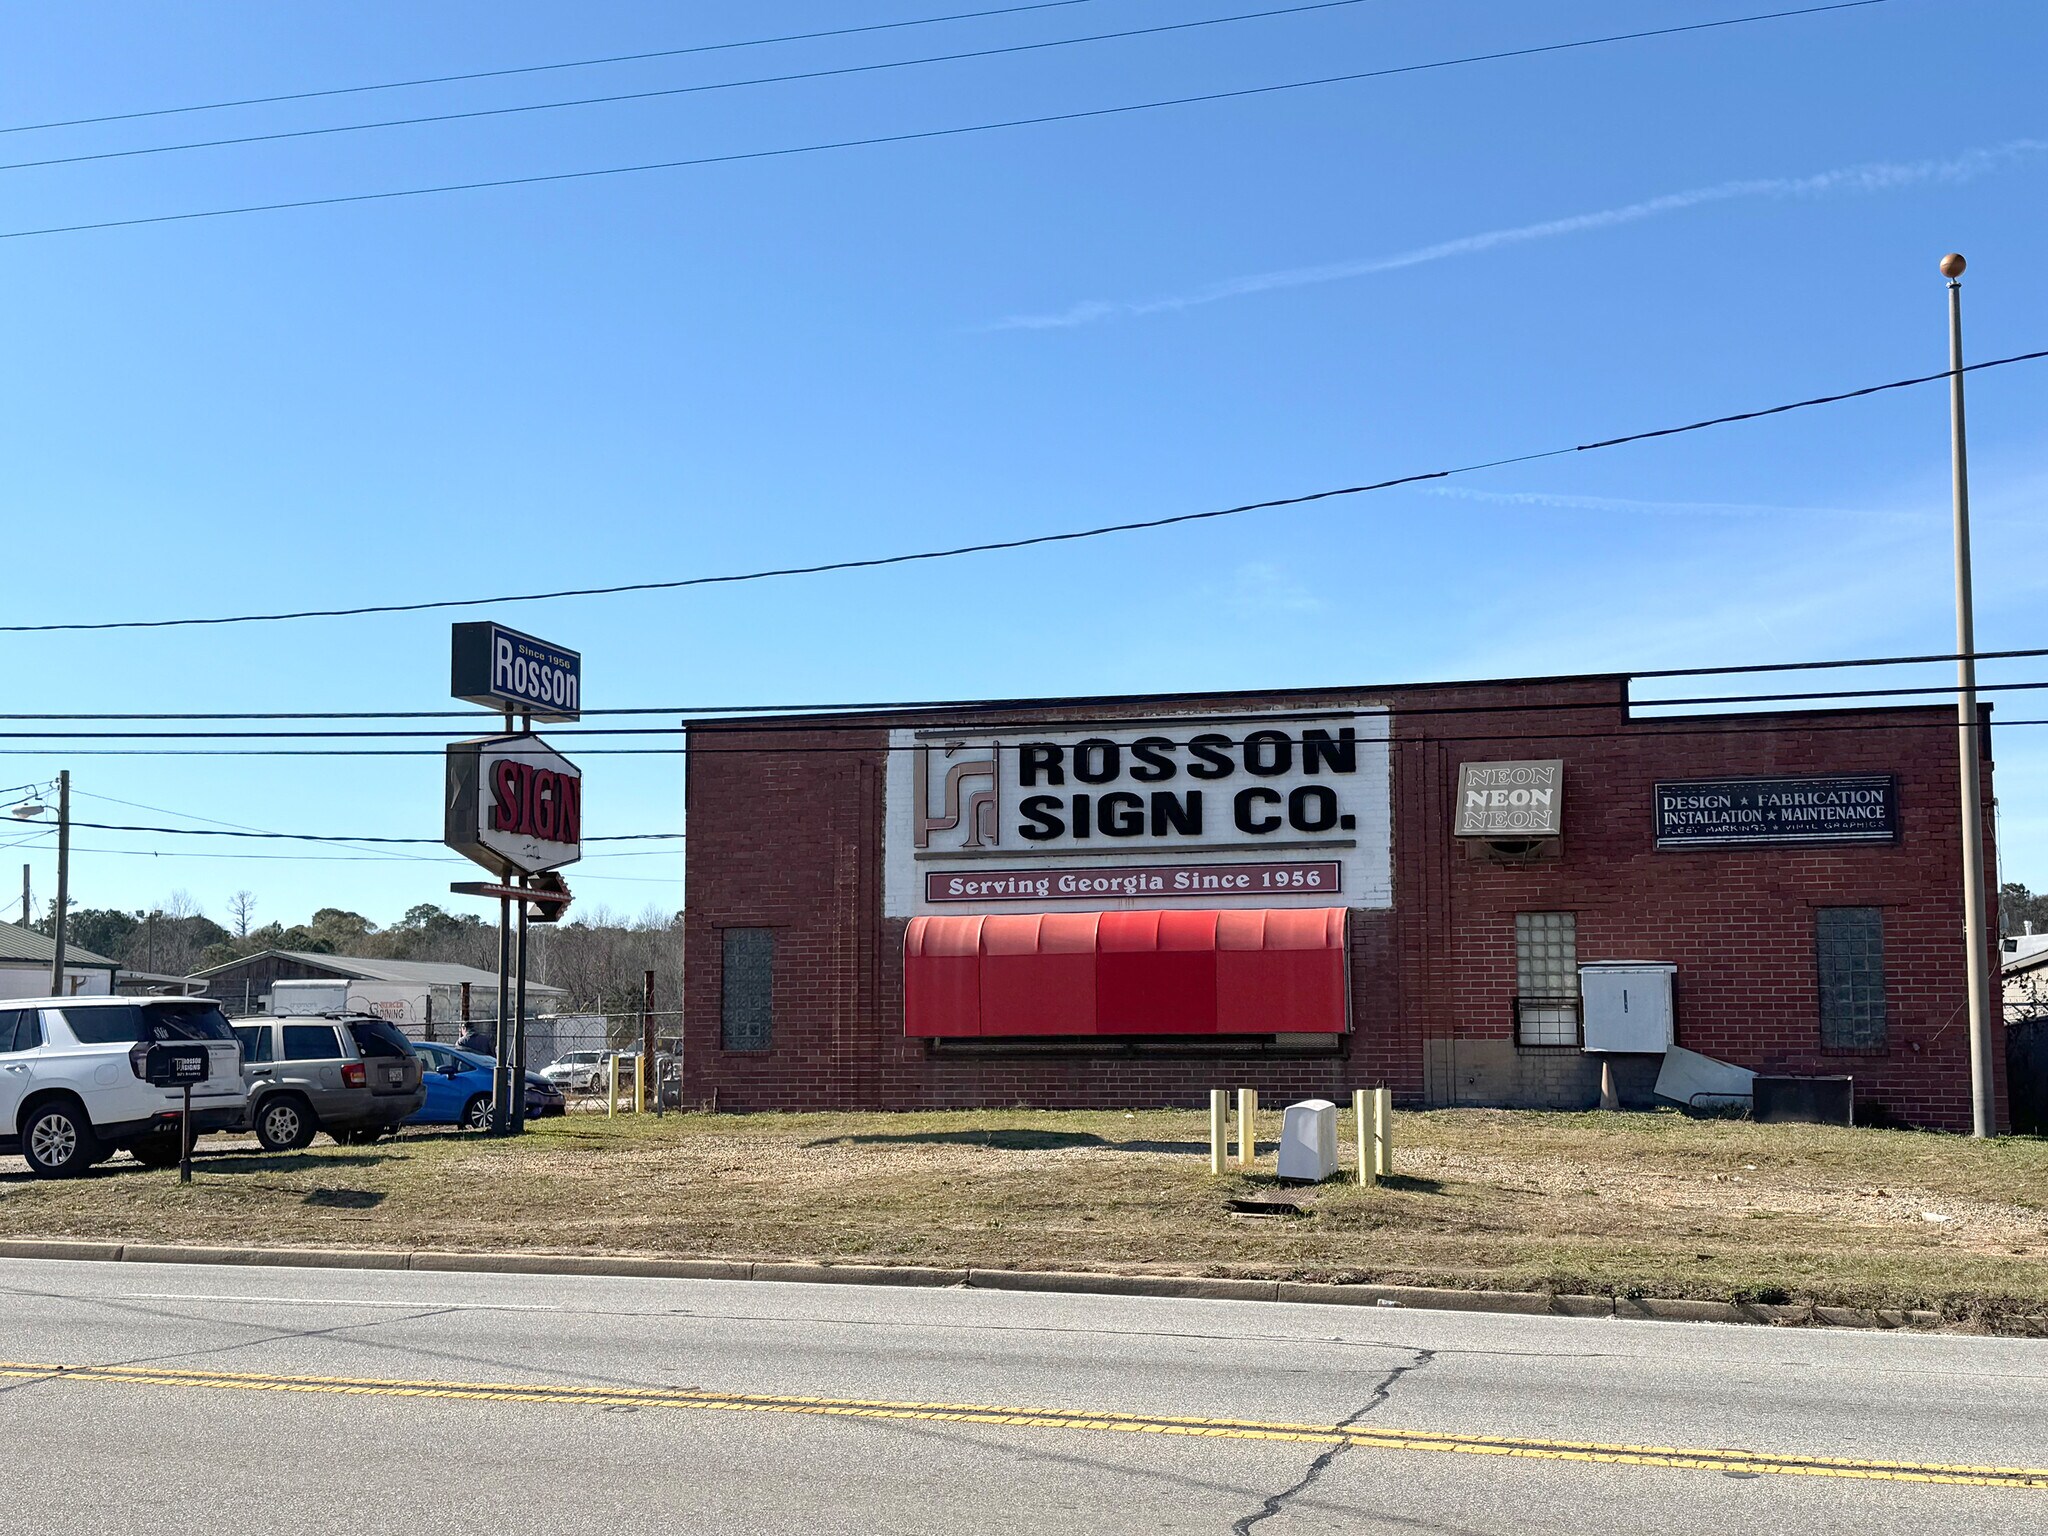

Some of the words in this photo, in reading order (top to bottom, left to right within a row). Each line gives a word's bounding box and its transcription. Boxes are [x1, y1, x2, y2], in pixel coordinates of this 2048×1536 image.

[518, 644, 545, 661] Since
[548, 655, 571, 669] 1956
[496, 637, 578, 709] Rosson
[1019, 727, 1356, 786] ROSSON
[1467, 766, 1555, 786] NEON
[489, 758, 580, 844] SIGN
[1465, 788, 1553, 807] NEON
[1663, 795, 1731, 810] DESIGN
[1758, 790, 1884, 806] FABRICATION
[1018, 790, 1202, 841] SIGN
[1234, 786, 1356, 834] CO.
[1464, 810, 1552, 828] NEON
[1664, 809, 1762, 825] INSTALLATION
[1781, 805, 1885, 821] MAINTENANCE
[1824, 820, 1885, 829] GRAPHICS
[948, 877, 1049, 898] Serving
[1058, 873, 1164, 896] Georgia
[1173, 872, 1250, 890] Since
[1262, 870, 1321, 888] 1956
